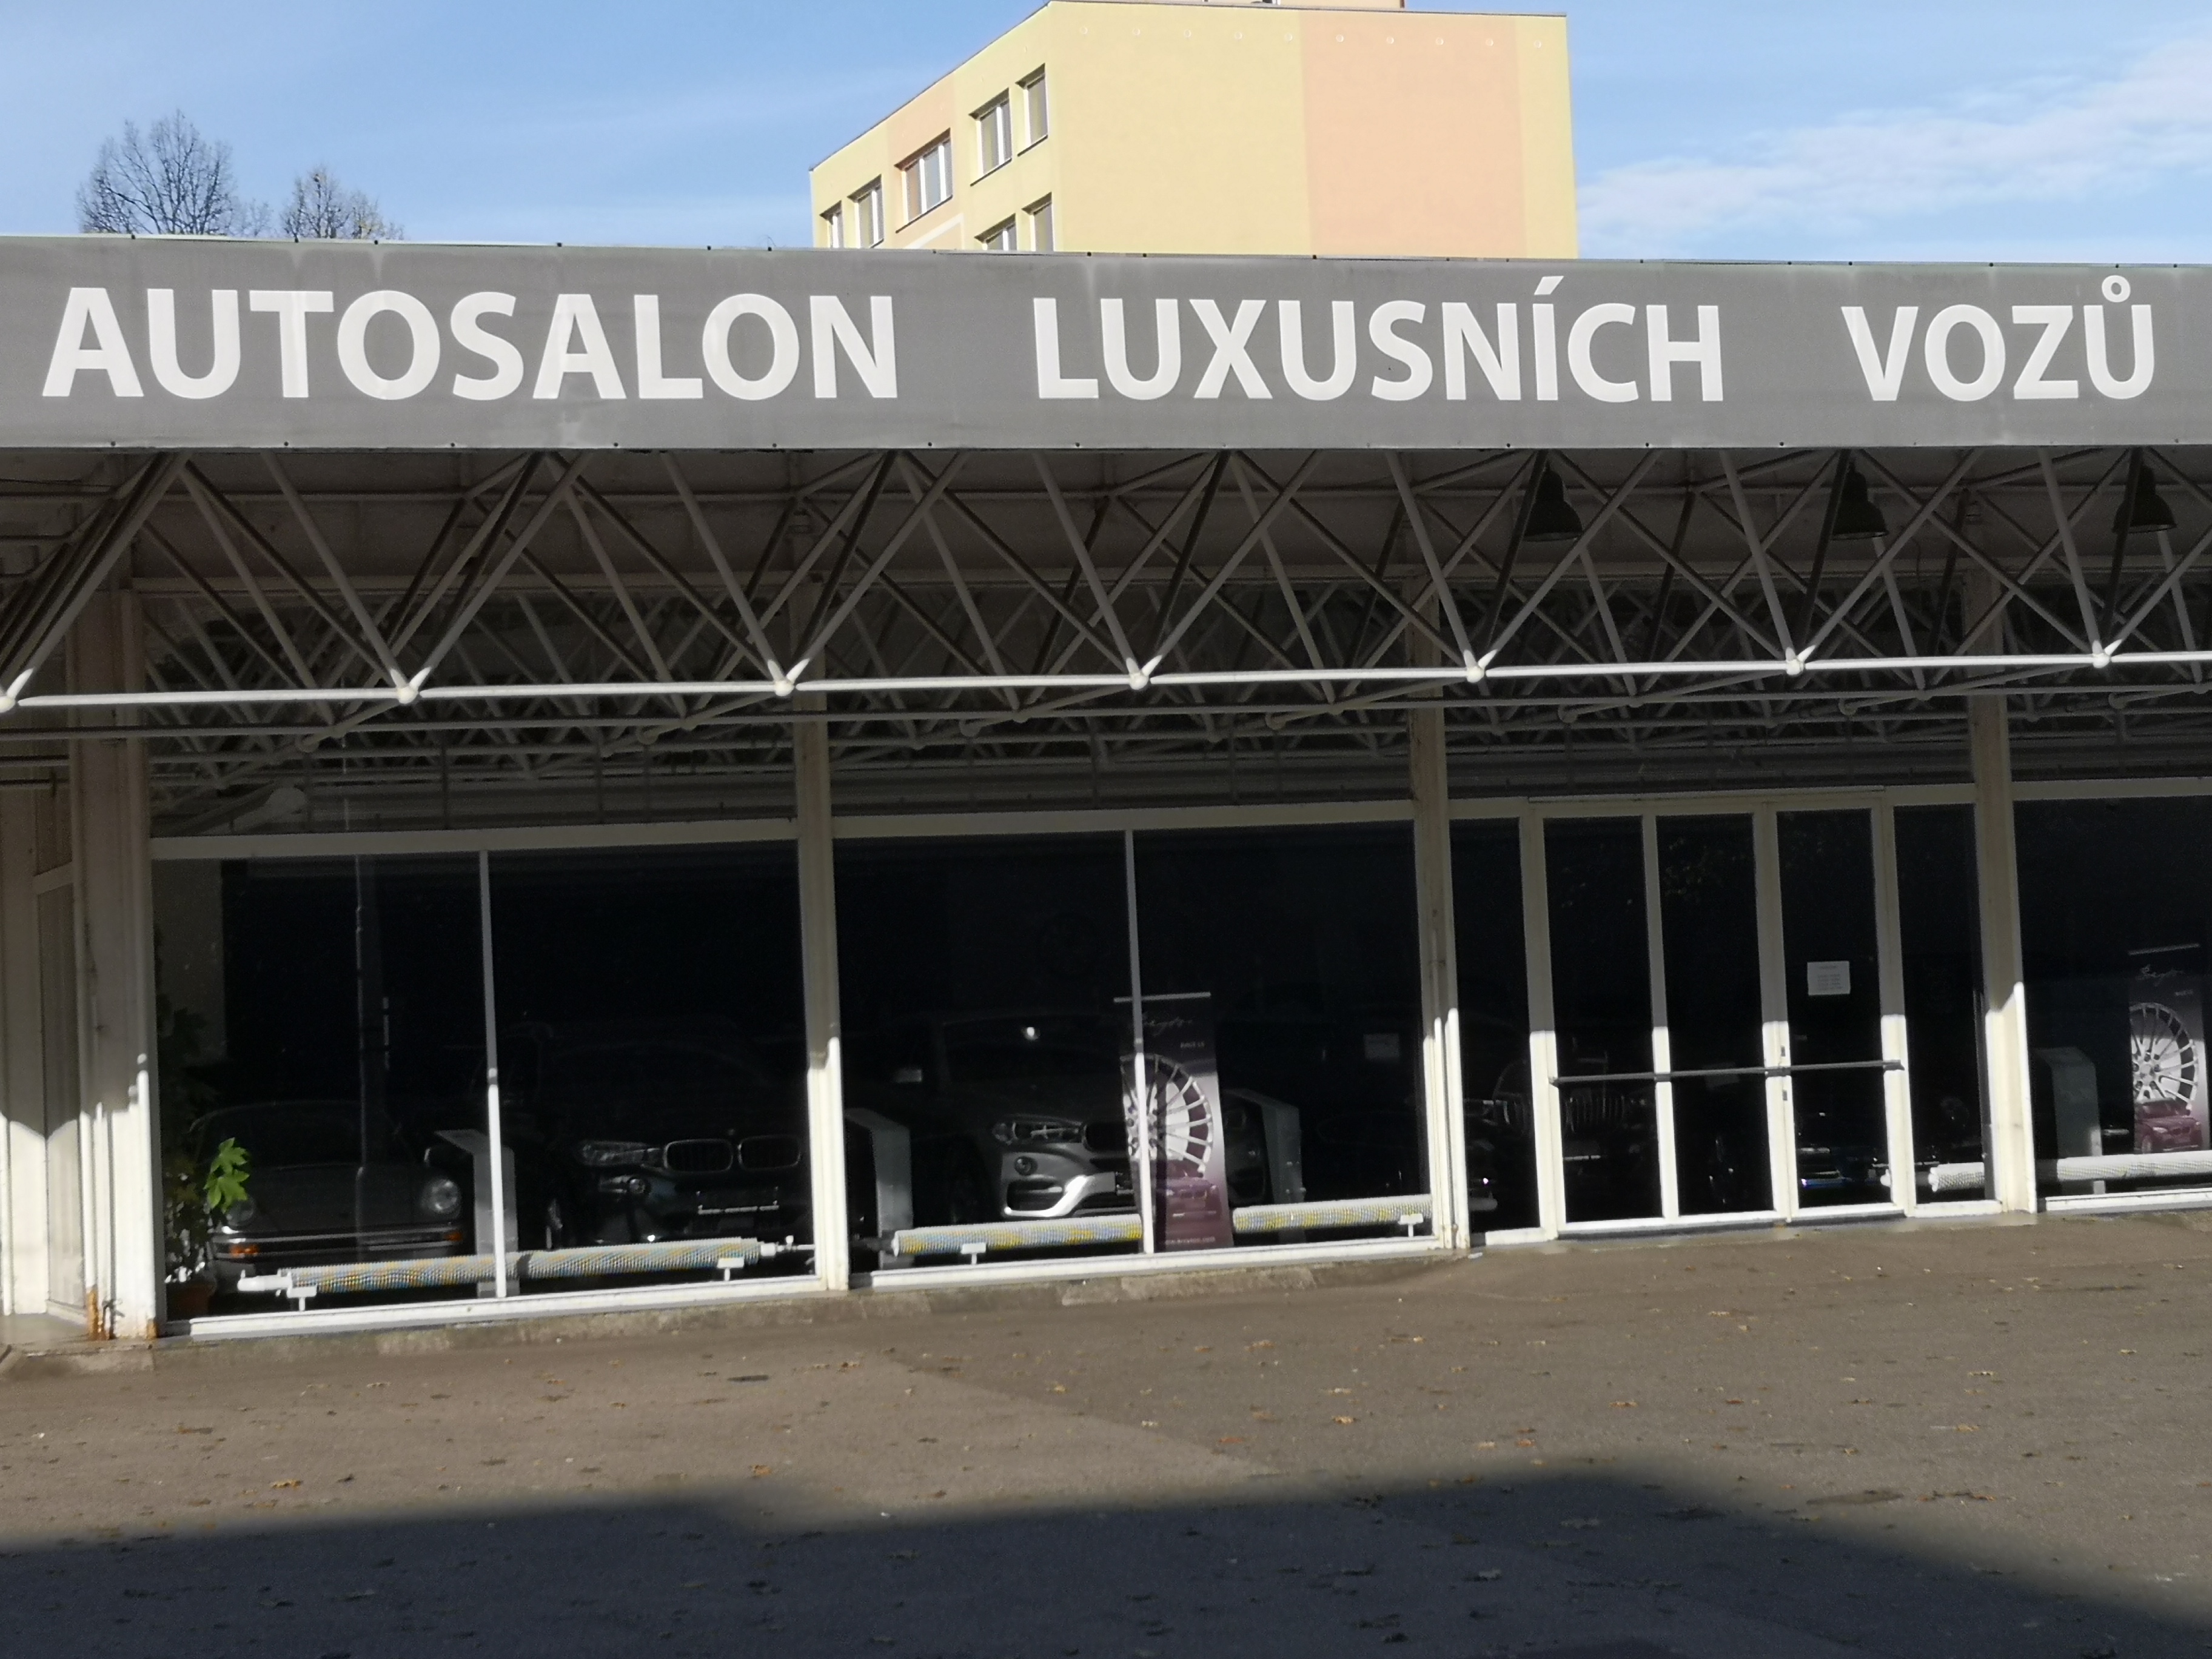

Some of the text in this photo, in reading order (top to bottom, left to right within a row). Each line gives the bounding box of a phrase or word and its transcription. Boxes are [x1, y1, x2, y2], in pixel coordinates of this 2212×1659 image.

[42, 275, 2156, 403] AUTOSALON LUXUSNÍCH VOZŮ
